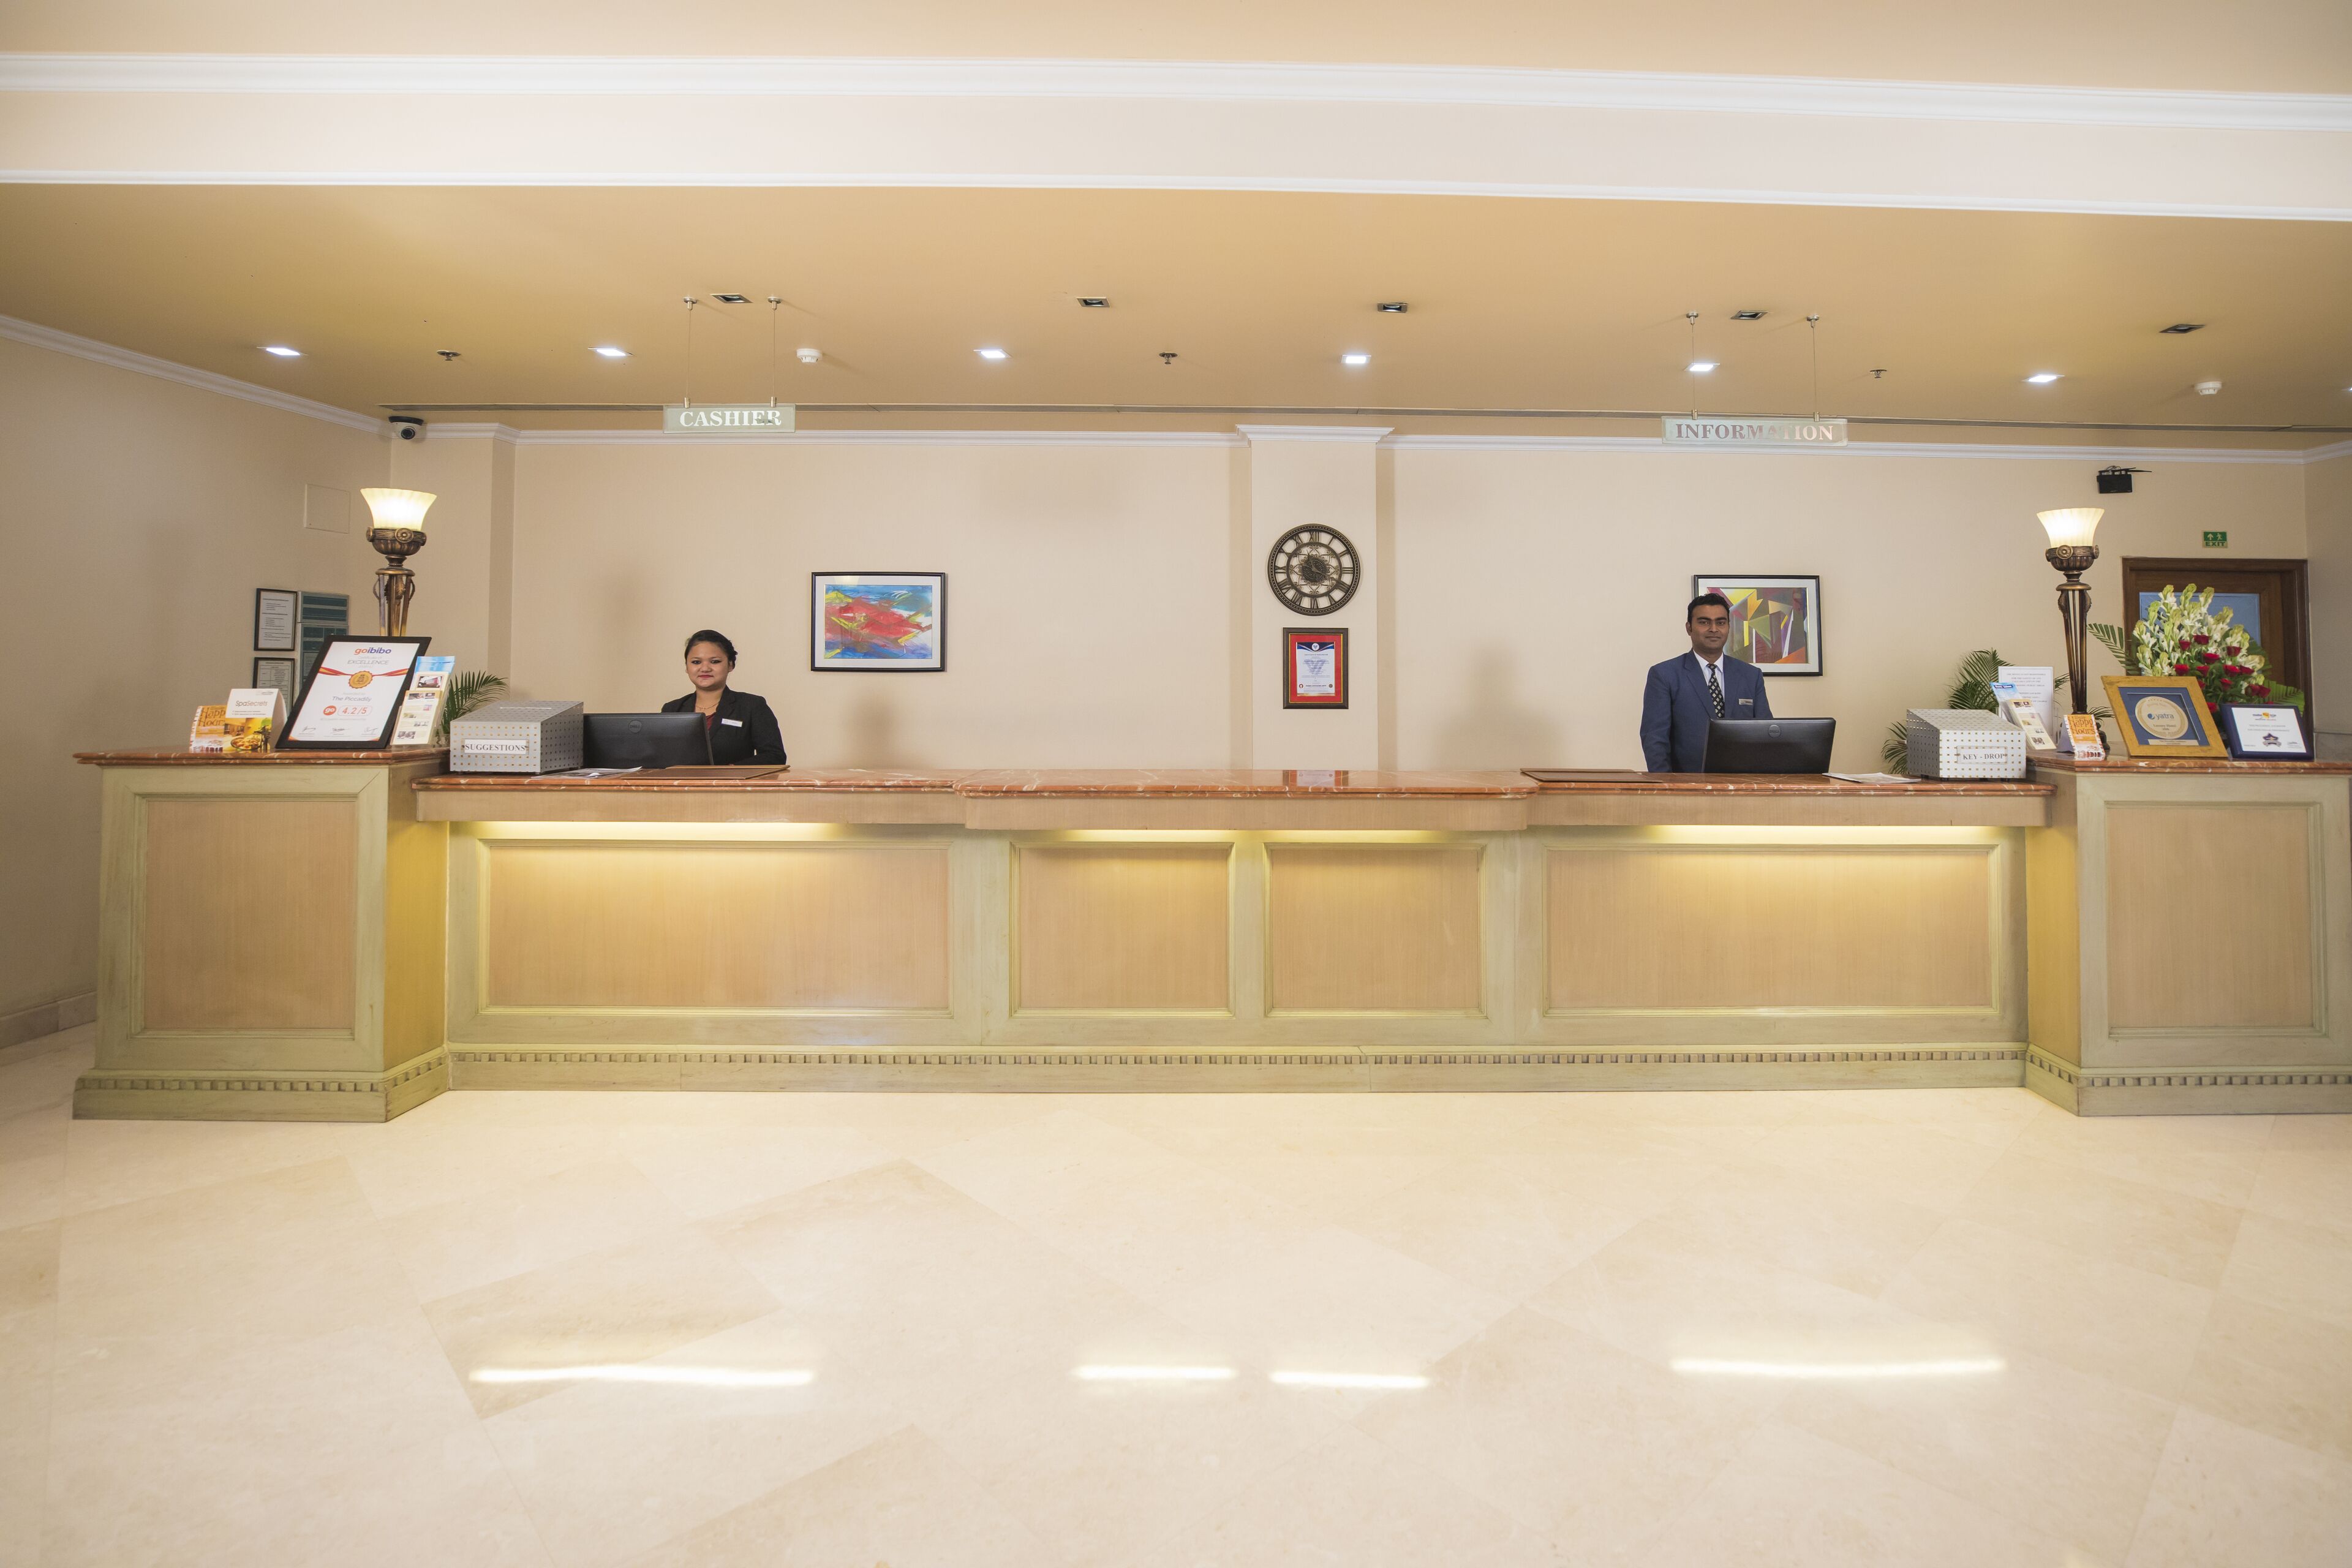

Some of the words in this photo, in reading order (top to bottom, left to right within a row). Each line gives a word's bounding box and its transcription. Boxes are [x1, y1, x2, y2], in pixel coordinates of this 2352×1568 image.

[680, 410, 782, 427] CASHIER
[1675, 423, 1833, 441] INFORMATION
[200, 707, 226, 719] Happ
[2068, 716, 2094, 728] Happy
[2071, 725, 2096, 734] Hours
